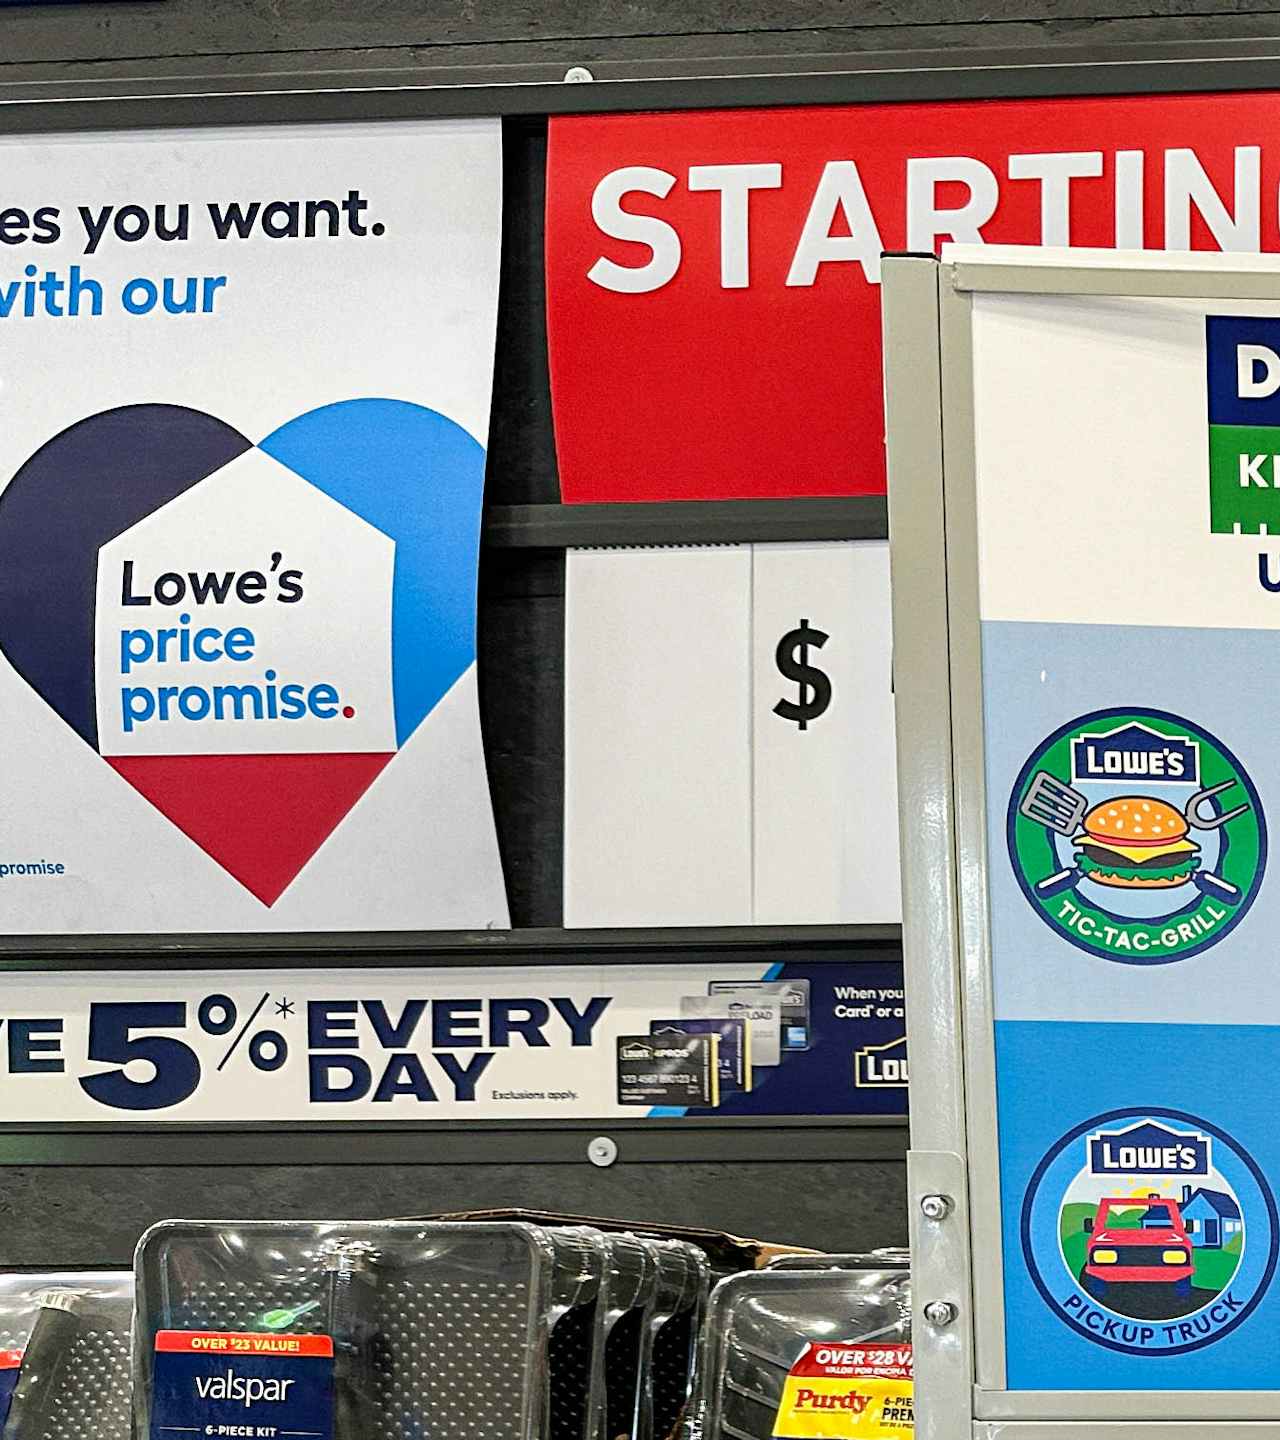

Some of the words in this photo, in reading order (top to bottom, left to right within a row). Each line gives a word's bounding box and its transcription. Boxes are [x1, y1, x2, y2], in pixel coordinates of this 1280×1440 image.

[0, 206, 61, 245] es
[77, 203, 189, 255] you
[206, 190, 385, 240] want.
[121, 275, 228, 316] our
[121, 551, 304, 607] Lowe's
[120, 612, 256, 675] price
[121, 669, 356, 733] promise.
[772, 618, 832, 731] $
[1087, 744, 1188, 779] LOWE'S
[0, 858, 66, 877] promise
[1056, 897, 1227, 954] TIC-TAC-GRILL
[834, 985, 875, 1002] When
[877, 987, 905, 1005] you
[876, 1006, 891, 1018] or
[893, 1007, 904, 1018] a
[0, 1016, 65, 1074] E
[306, 996, 613, 1050] EVERY
[307, 1052, 497, 1104] DAY
[490, 1088, 547, 1101] Exclusions
[546, 1089, 579, 1101] apply.
[1100, 1143, 1197, 1173] LOWE'S
[1062, 1289, 1157, 1349] PICKUP
[1164, 1289, 1245, 1349] TRUCK
[195, 1368, 296, 1408] valspar
